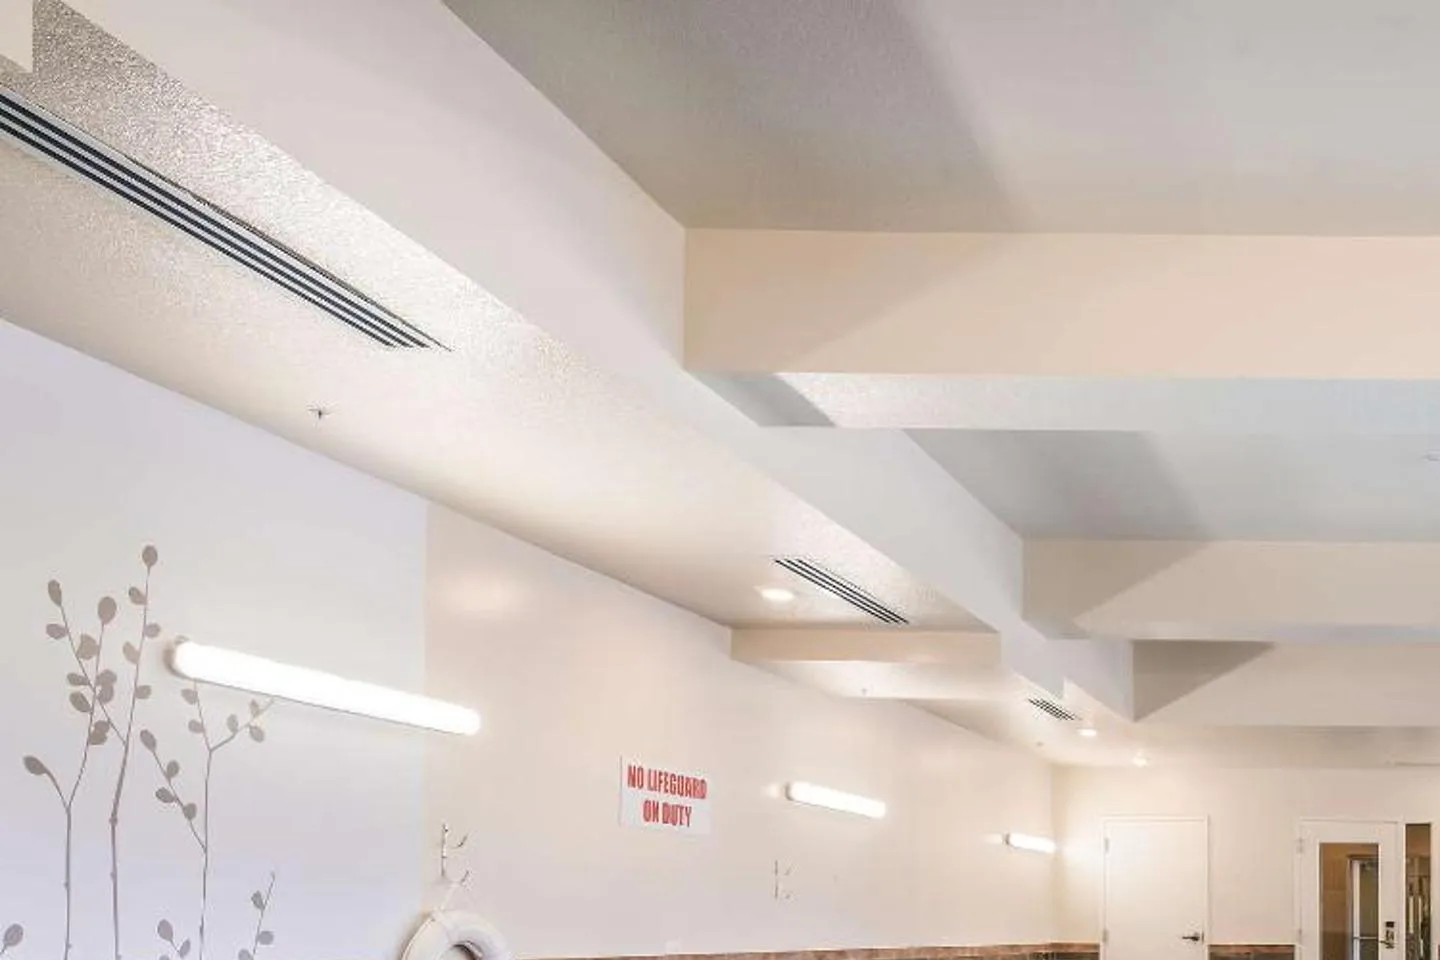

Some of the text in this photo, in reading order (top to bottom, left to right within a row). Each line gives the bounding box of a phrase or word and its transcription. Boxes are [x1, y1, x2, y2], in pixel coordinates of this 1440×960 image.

[628, 765, 707, 799] NO LIFEGUARD
[643, 799, 692, 827] ON DUTY
